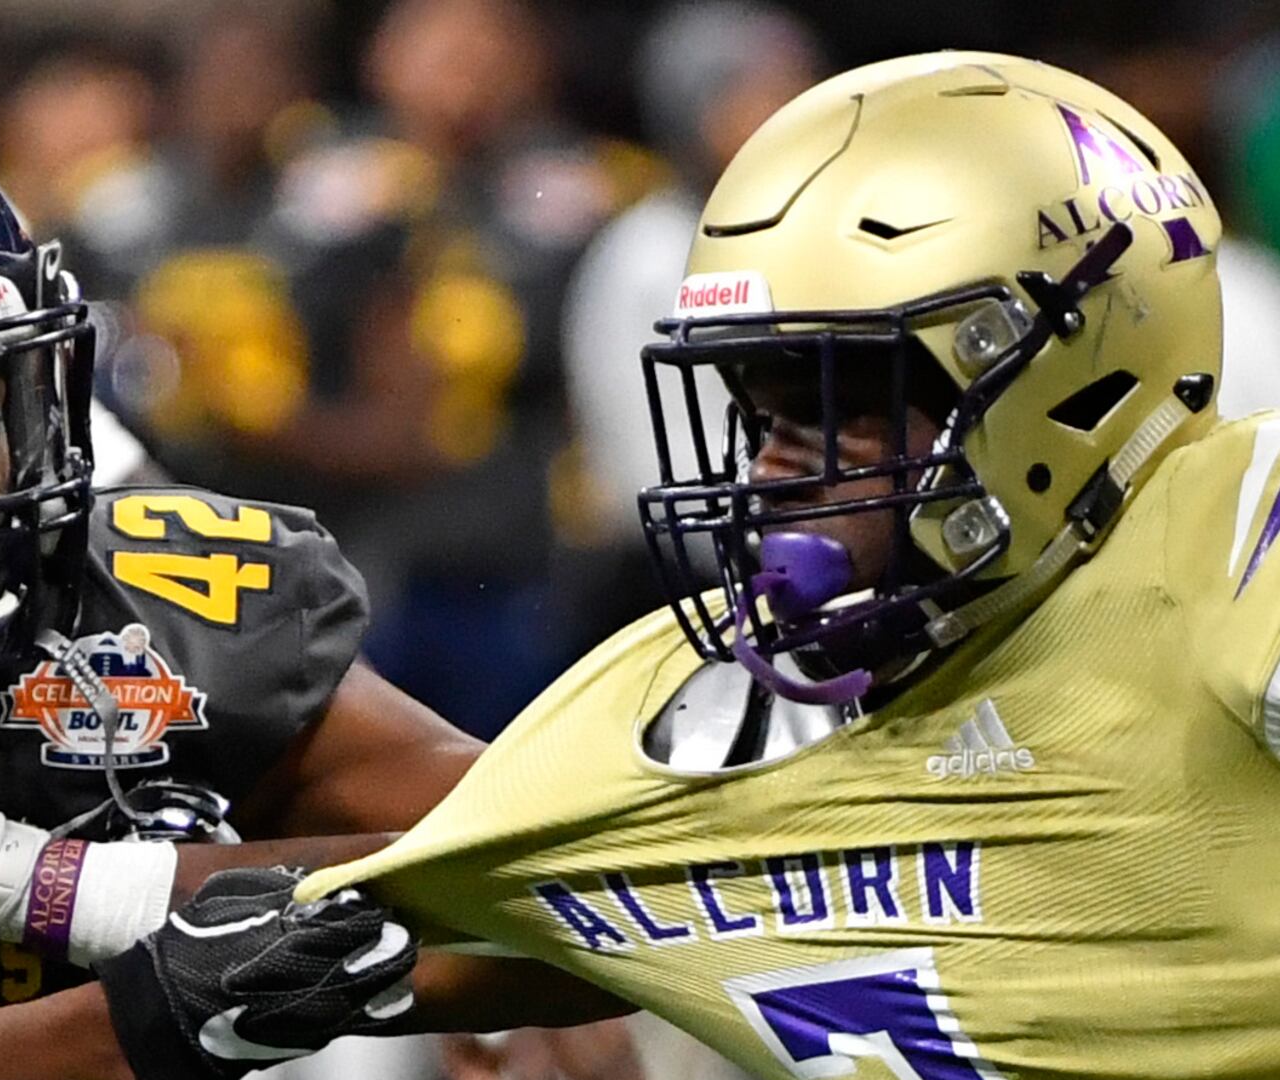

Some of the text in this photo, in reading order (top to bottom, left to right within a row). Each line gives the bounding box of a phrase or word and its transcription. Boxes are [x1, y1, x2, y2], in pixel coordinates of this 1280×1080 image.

[1037, 172, 1206, 250] ALCORN
[679, 279, 750, 309] Riddell
[112, 494, 272, 625] 42
[31, 683, 174, 704] CELEATION
[926, 747, 1035, 781] adidas
[30, 838, 65, 935] ALCORN
[531, 840, 983, 953] ALCORN
